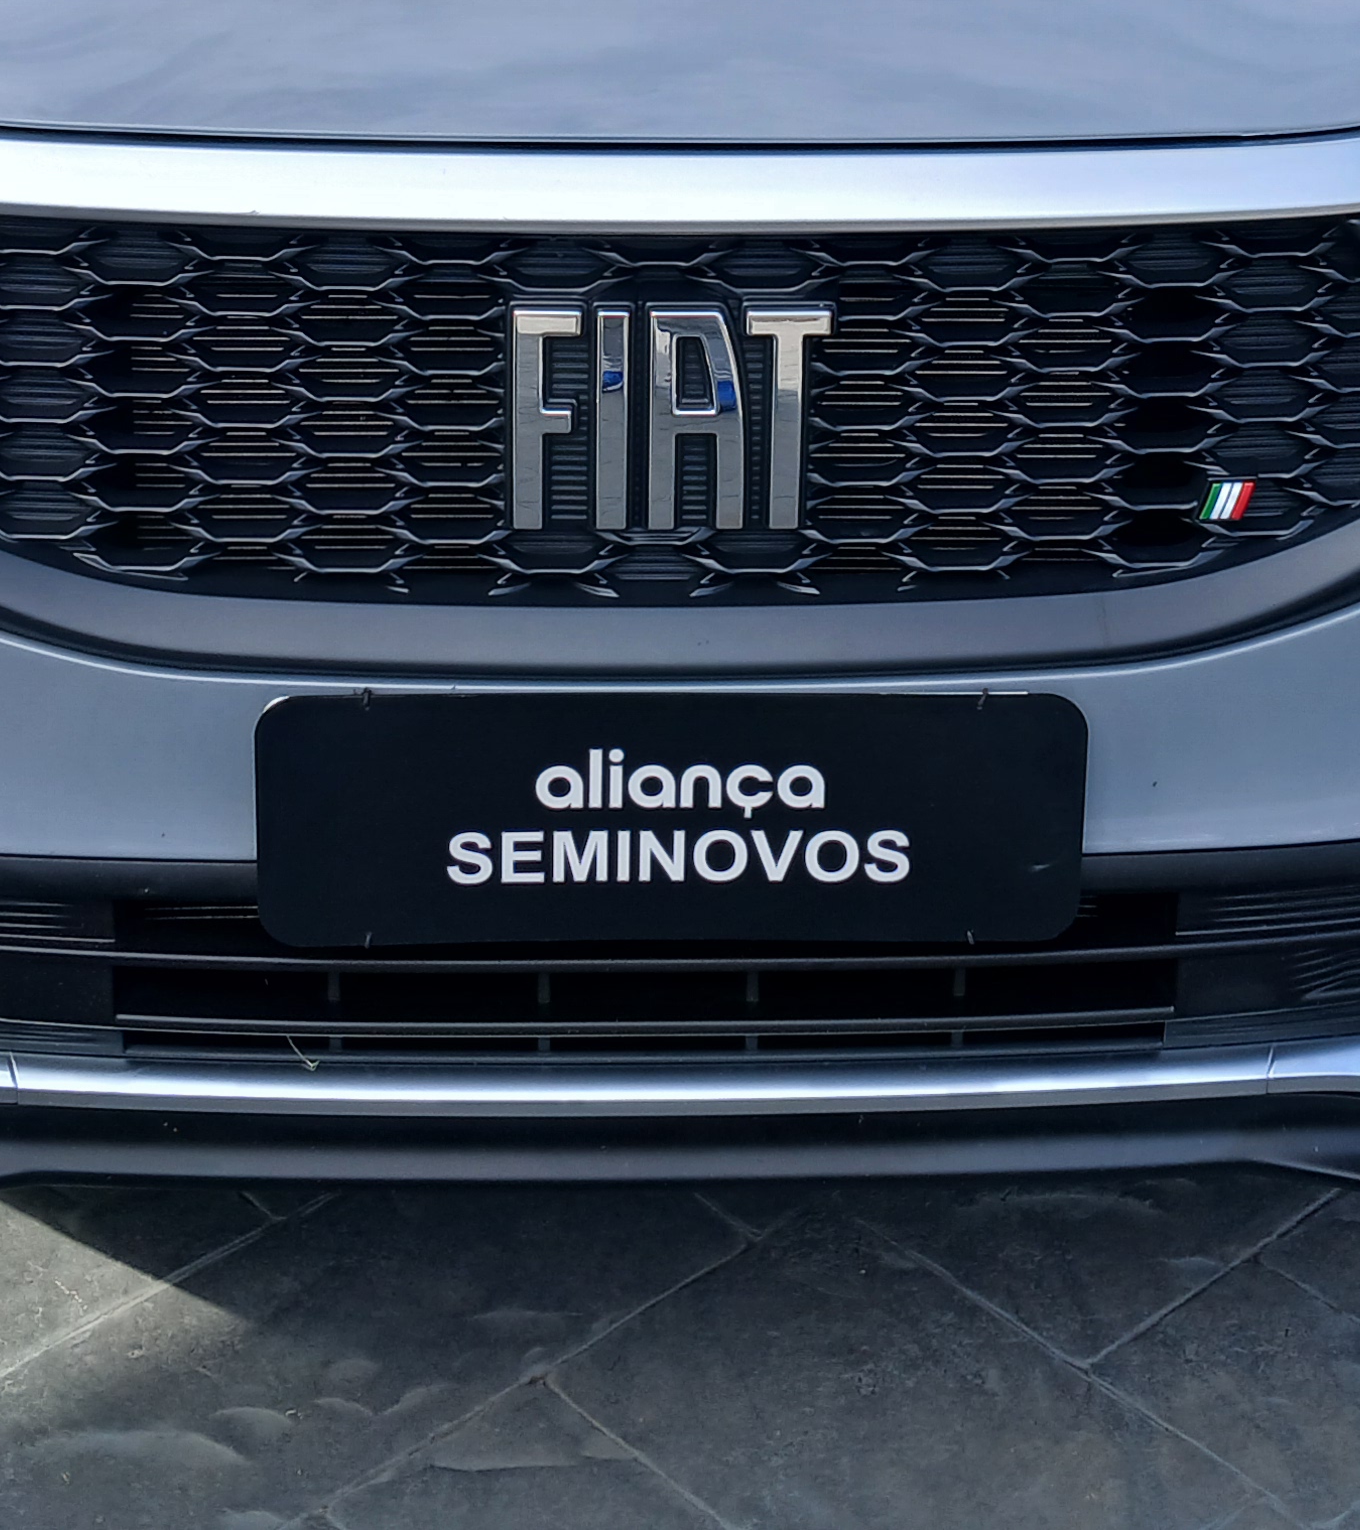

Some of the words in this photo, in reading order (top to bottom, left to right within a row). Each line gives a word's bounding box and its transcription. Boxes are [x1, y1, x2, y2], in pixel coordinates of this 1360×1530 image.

[510, 302, 835, 531] FIAT
[535, 748, 827, 819] aliança
[445, 829, 912, 886] SEMINOVOS
